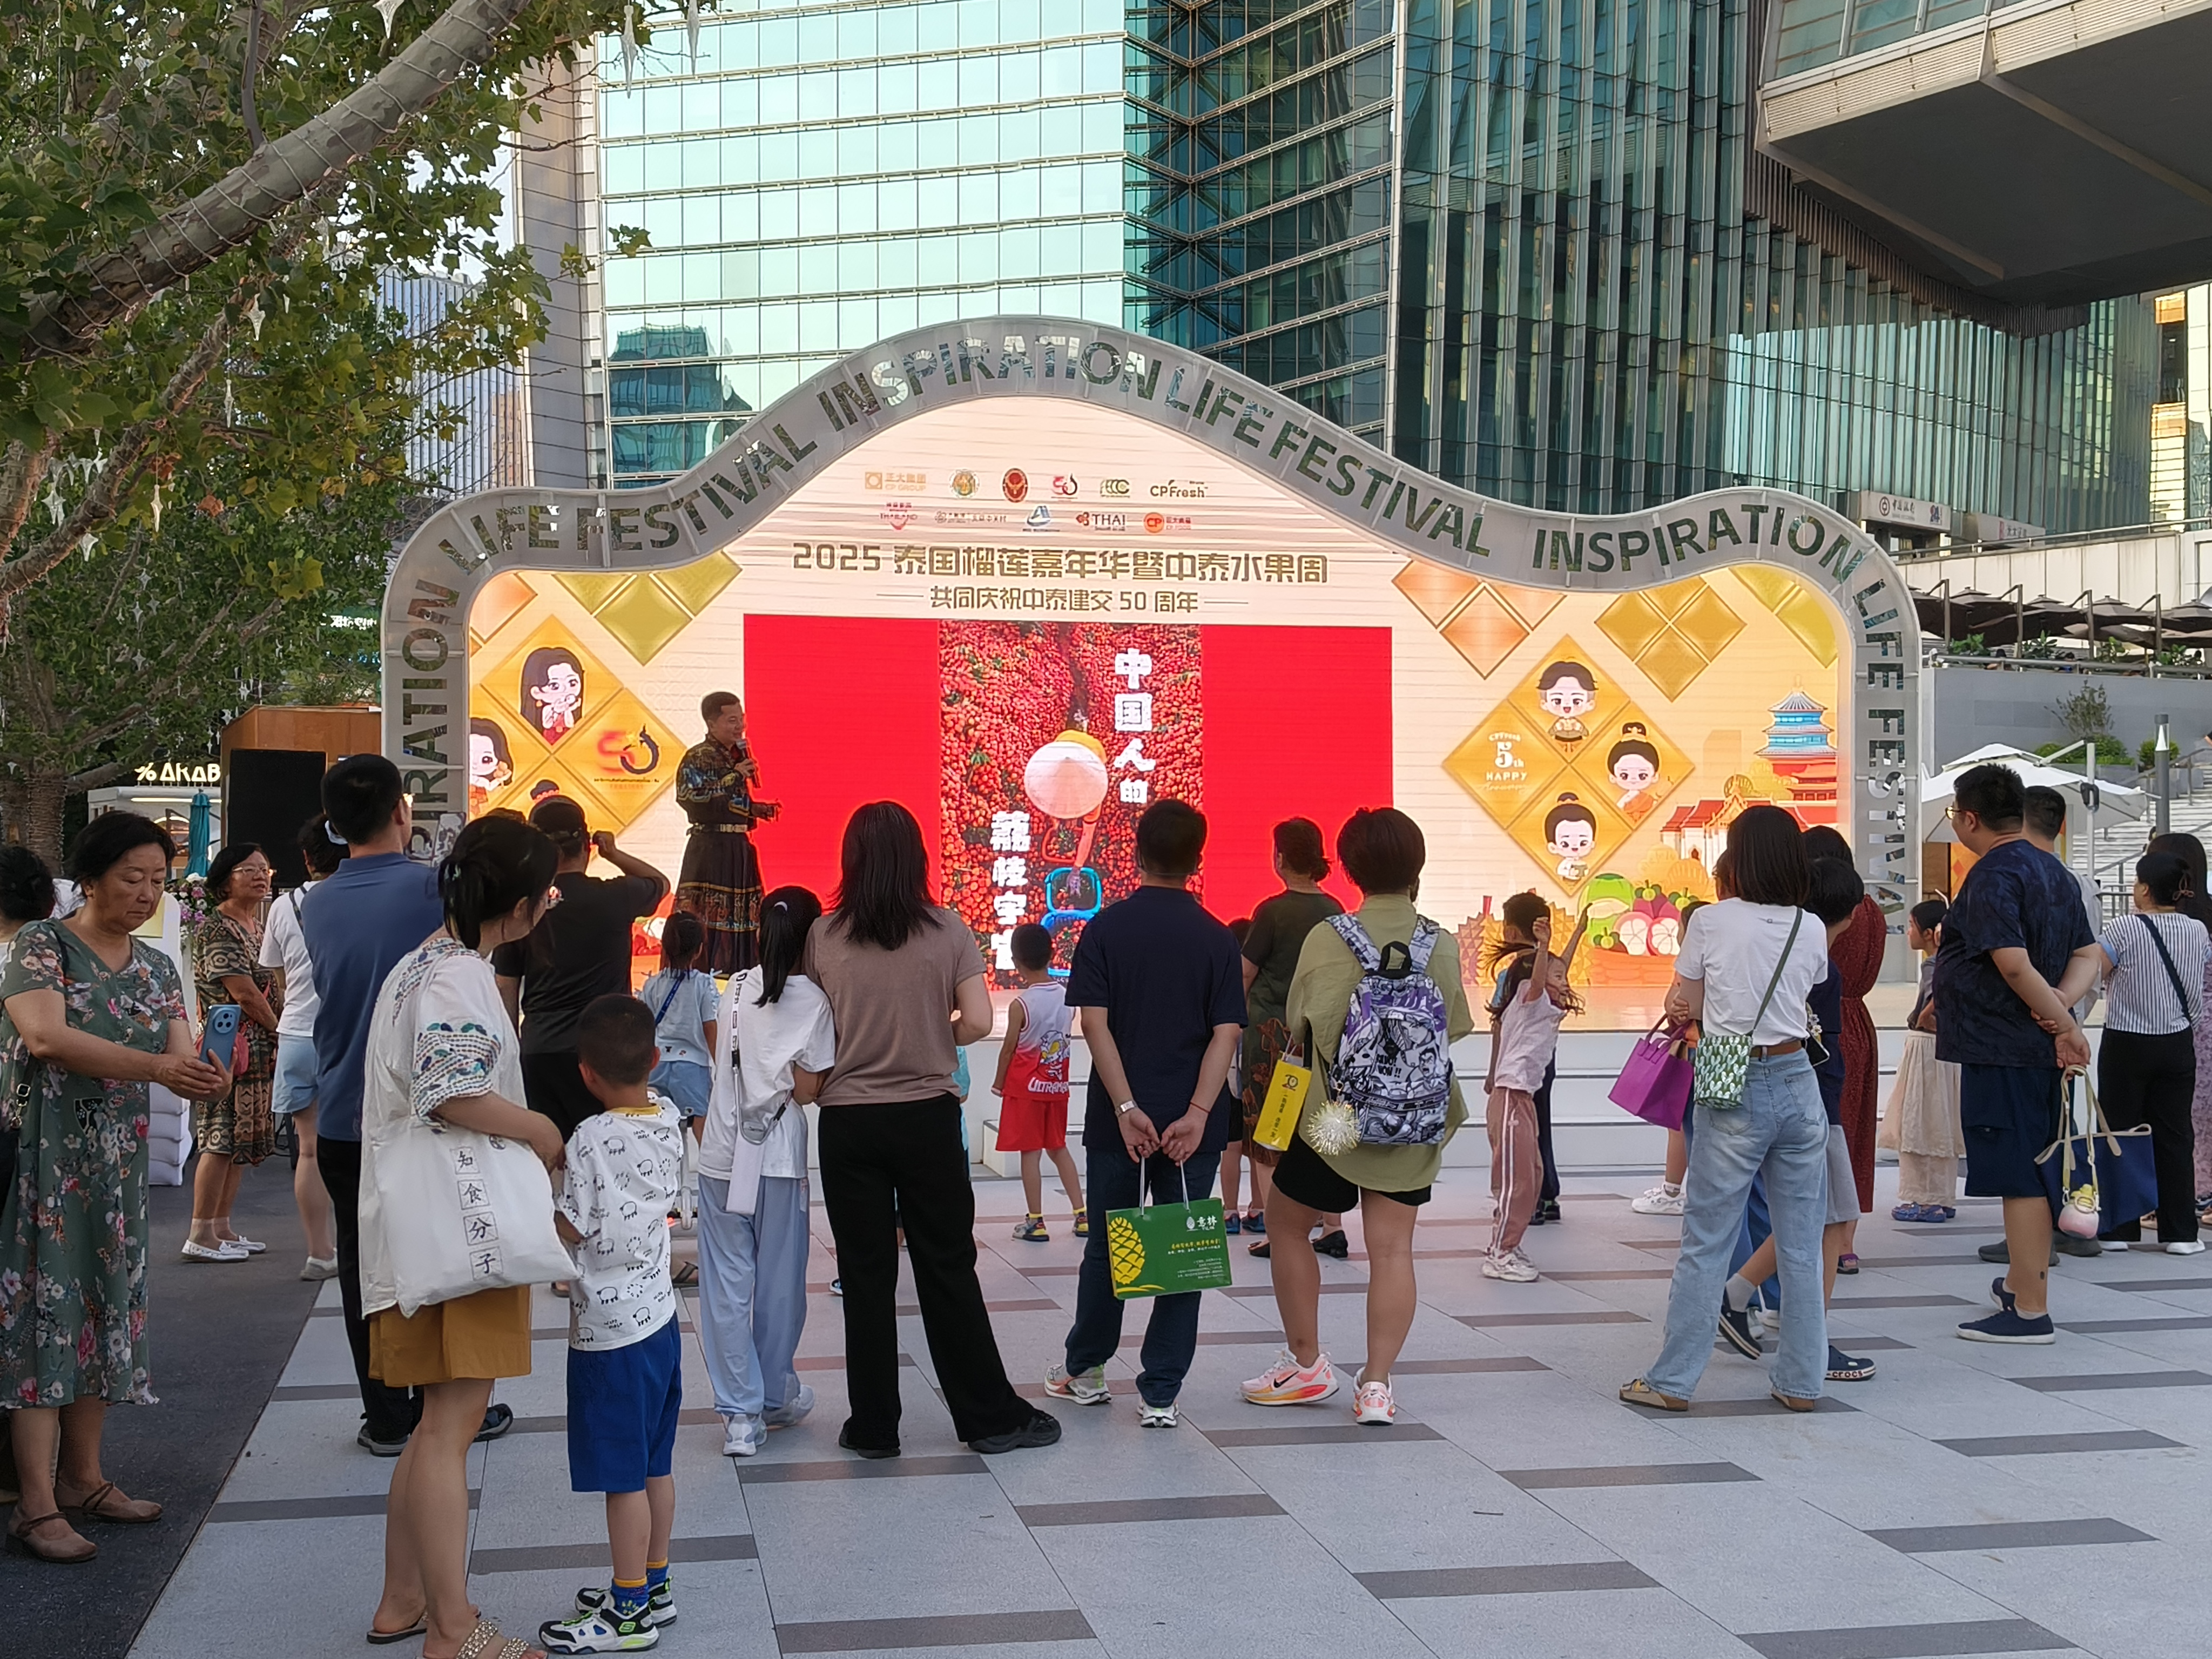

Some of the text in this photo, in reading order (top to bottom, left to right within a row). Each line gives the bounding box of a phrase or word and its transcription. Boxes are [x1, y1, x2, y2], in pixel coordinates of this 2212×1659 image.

[438, 504, 560, 575] LIFE
[577, 423, 818, 552] FESTIVAL
[817, 335, 1161, 432] INSPIRATION
[1165, 366, 1274, 448] LIFE
[1269, 420, 1491, 557] FESTIVAL
[1532, 503, 1866, 584] INSPIRATION
[1852, 578, 1904, 690] LIFE
[1092, 514, 1126, 525] THAI
[793, 542, 1328, 583] 2025 泰国榴莲嘉年华暨中泰水果周
[930, 585, 1198, 613] 共同庆祝中泰建交 50 周年
[1114, 648, 1156, 804] 中国人的
[1486, 771, 1528, 781] HAPPY
[457, 1151, 496, 1274] 知食分子
